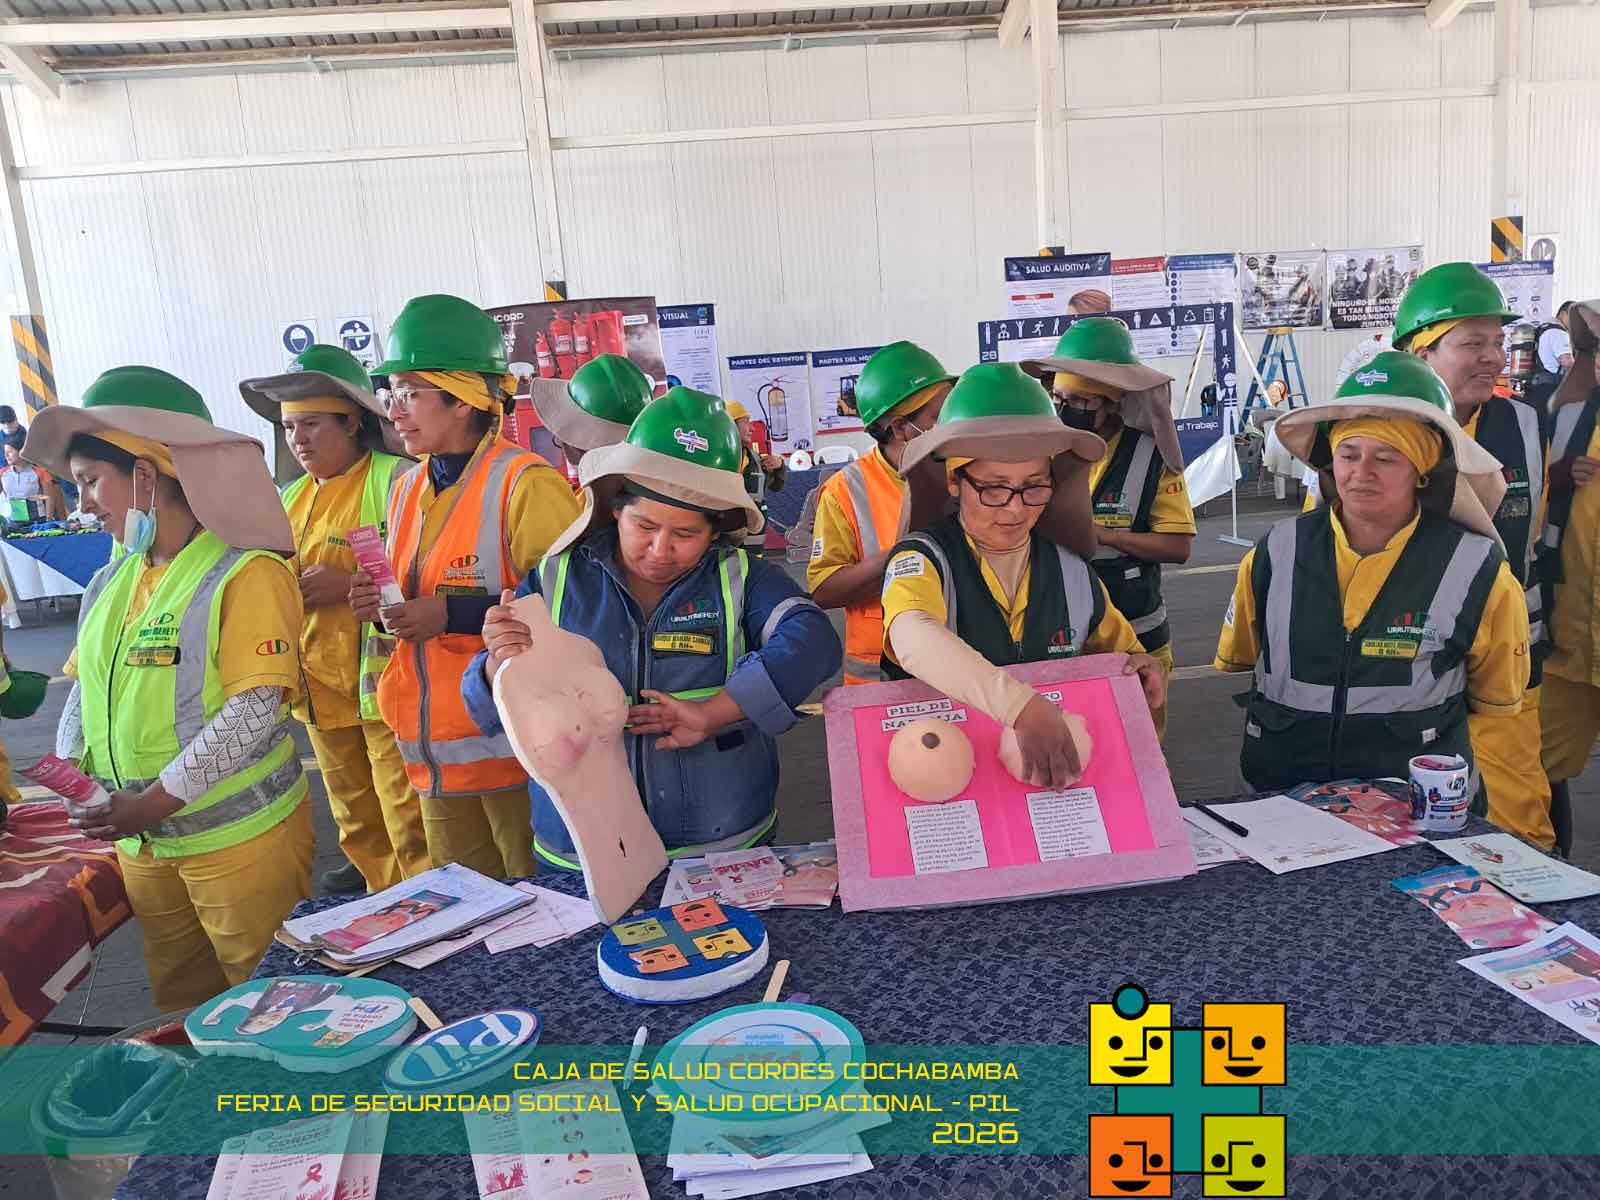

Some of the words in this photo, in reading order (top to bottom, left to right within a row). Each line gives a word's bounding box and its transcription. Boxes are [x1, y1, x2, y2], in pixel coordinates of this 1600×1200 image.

[1025, 265, 1051, 274] SALUD
[1053, 263, 1091, 272] AUDITIVA
[662, 312, 689, 321] VISUAL
[1343, 313, 1367, 321] TODOS
[1368, 312, 1397, 320] NOSOT
[731, 358, 757, 366] PARTES
[772, 355, 805, 363] EXTINTOR
[1185, 421, 1218, 431] Trabajo
[889, 705, 926, 716] PIEL
[929, 701, 950, 710] DE
